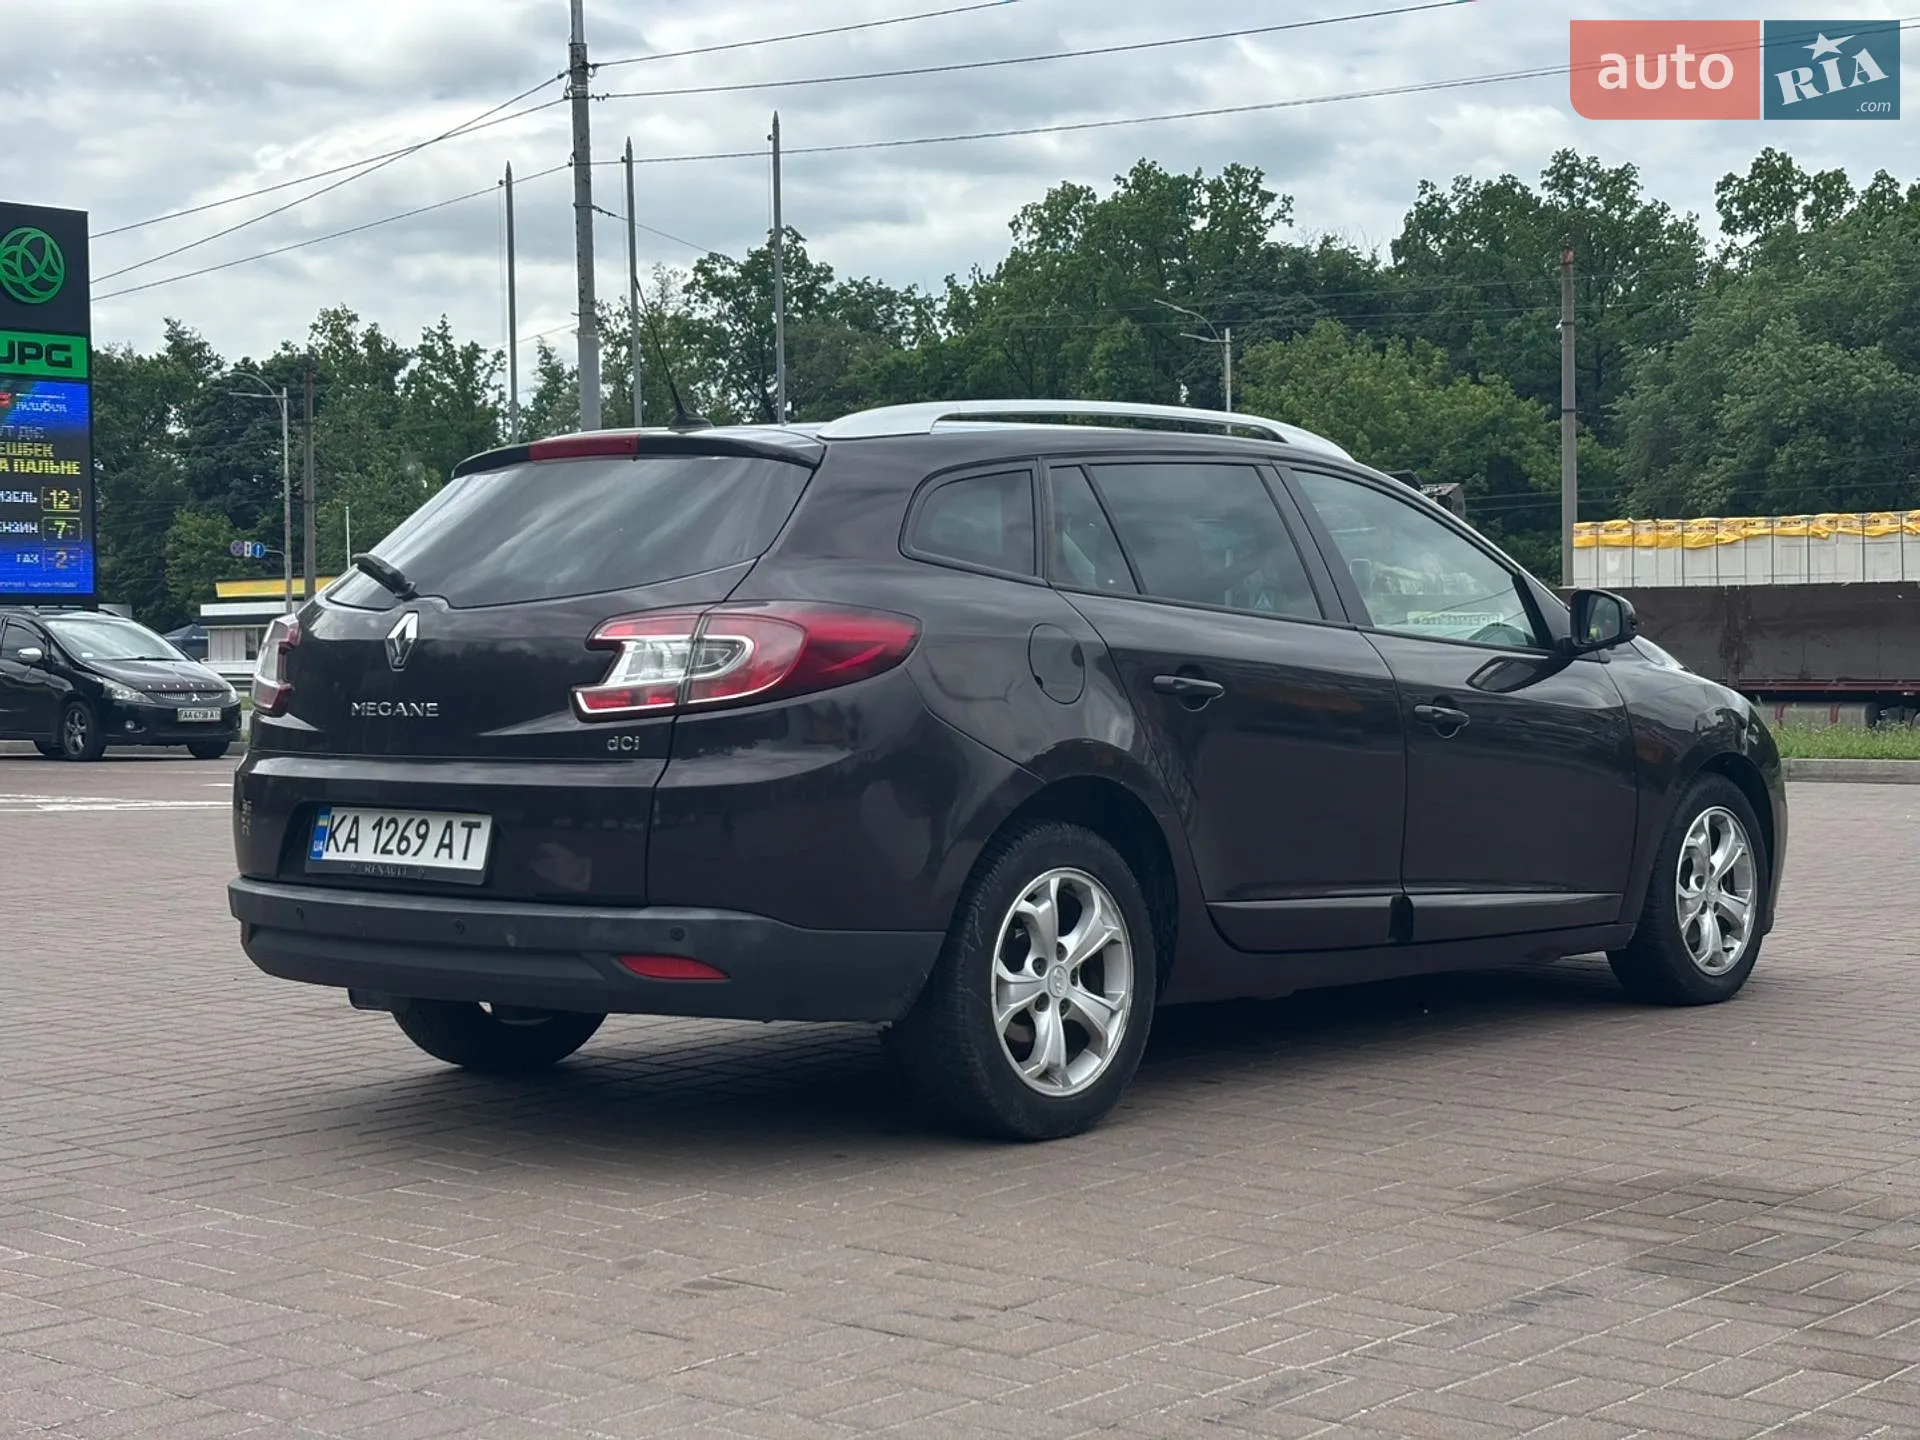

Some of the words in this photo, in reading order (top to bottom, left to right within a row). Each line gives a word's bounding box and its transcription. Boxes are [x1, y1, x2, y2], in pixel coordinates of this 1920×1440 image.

[13, 458, 81, 475] ПАЛЬНЕ
[351, 701, 440, 717] MEGANE
[607, 735, 640, 751] dCi
[326, 814, 360, 853] KA
[371, 815, 431, 857] 1269
[434, 819, 482, 861] AT
